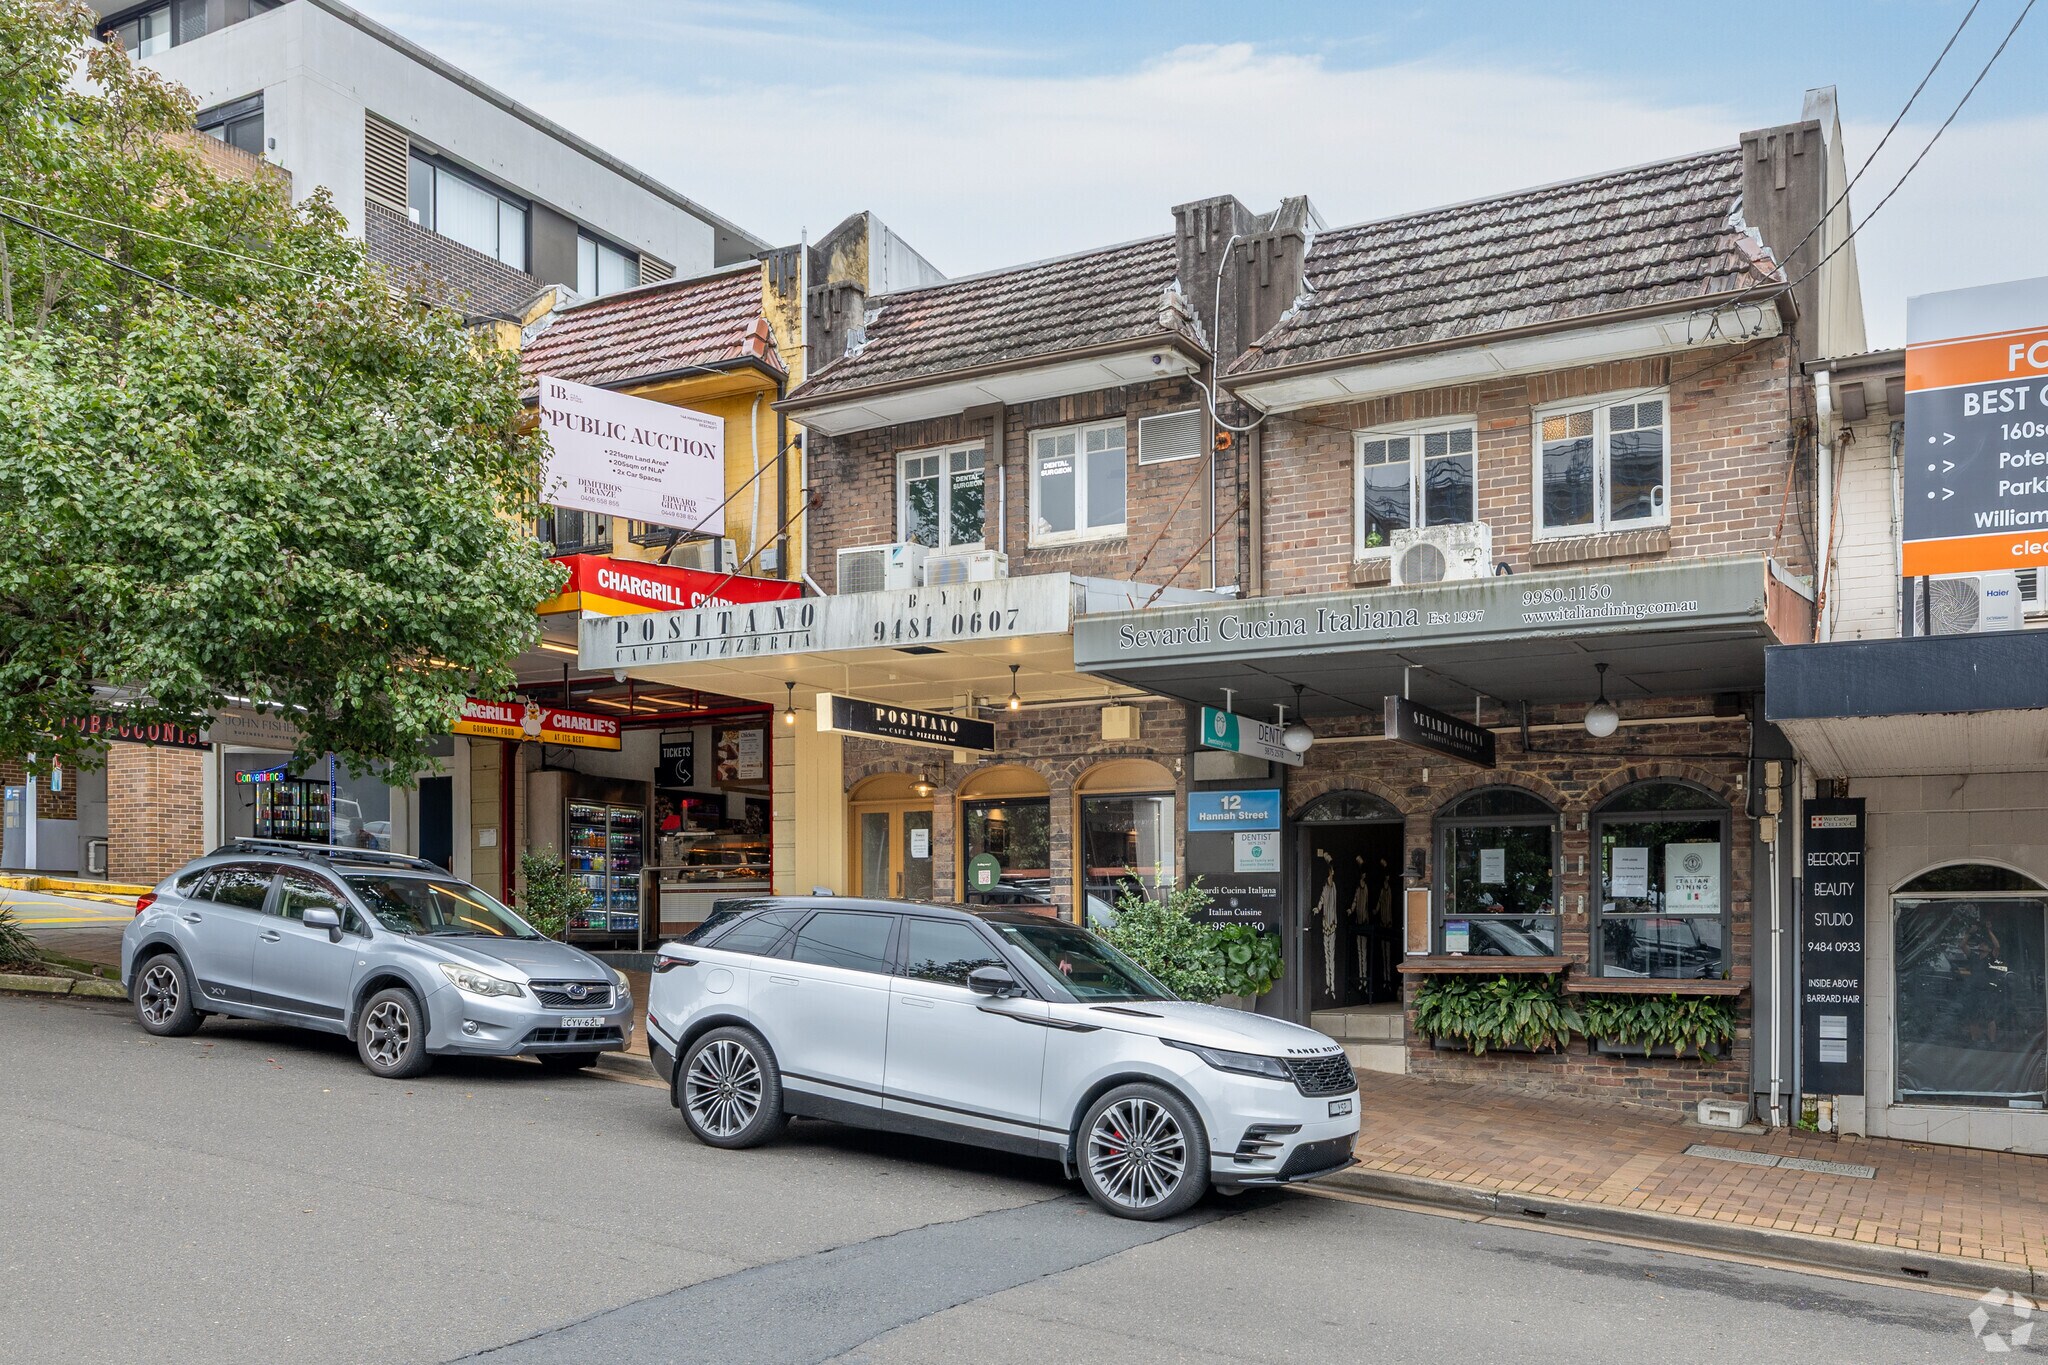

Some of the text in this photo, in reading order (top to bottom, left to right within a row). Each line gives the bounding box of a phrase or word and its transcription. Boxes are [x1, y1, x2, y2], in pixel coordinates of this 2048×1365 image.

[550, 384, 569, 400] IB.
[1964, 386, 2030, 416] BEST
[552, 409, 716, 460] PUBLIC AUCTION
[609, 449, 634, 460] 221sqm
[634, 454, 651, 464] Land
[1999, 449, 2048, 469] Pote
[613, 459, 640, 470] 205sqm
[640, 464, 647, 472] of
[1040, 466, 1073, 477] SURGEON
[1043, 460, 1070, 470] DENTAL
[617, 468, 662, 483] 2x Car Spaces
[955, 473, 980, 483] DENTAL
[578, 478, 622, 492] DIMITRIOS
[584, 486, 616, 498] FRANZE
[953, 480, 983, 490] SURGEON
[661, 502, 697, 513] GHATTAS
[662, 494, 696, 507] EDWARD
[598, 568, 684, 607] CHARGRILL
[1523, 583, 1612, 606] 9980.1150
[1986, 589, 2009, 597] Haier
[1522, 600, 1698, 623] www.italiandining.com.au
[616, 603, 814, 644] POSITANO
[873, 608, 1019, 642] 9481 0607
[1119, 604, 1485, 649] Sevardi Cucina Italiana Est 1997
[616, 633, 811, 663] CAFE PIZZERIA
[225, 716, 259, 729] JOHN
[552, 714, 617, 734] CHARLIE'S
[875, 707, 959, 734] POSITANO
[1413, 711, 1453, 736] SEVARDI
[472, 725, 584, 743] GOURMET FOOD AT ITS BEST
[889, 727, 906, 736] CAFE
[916, 731, 947, 742] PIZZERIA
[663, 747, 691, 758] TICKETS
[236, 771, 284, 783] Convenience
[1220, 795, 1241, 810] 12
[1199, 810, 1269, 821] Hannah Street
[1241, 833, 1272, 842] DENTIST
[1807, 851, 1861, 867] BEECROFT
[1220, 886, 1247, 895] Cucina
[1248, 886, 1277, 895] Italiana
[1813, 882, 1855, 896] BEAUTY
[1208, 907, 1263, 916] Italian Cuisine
[1814, 912, 1854, 927] STUDIO
[1807, 941, 1861, 953] 9484 0933
[210, 986, 226, 996] XV
[1808, 979, 1859, 989] INSIDE ABOVE
[1806, 994, 1860, 1004] BARRARD HAIR
[1322, 1044, 1341, 1053] ROVER
